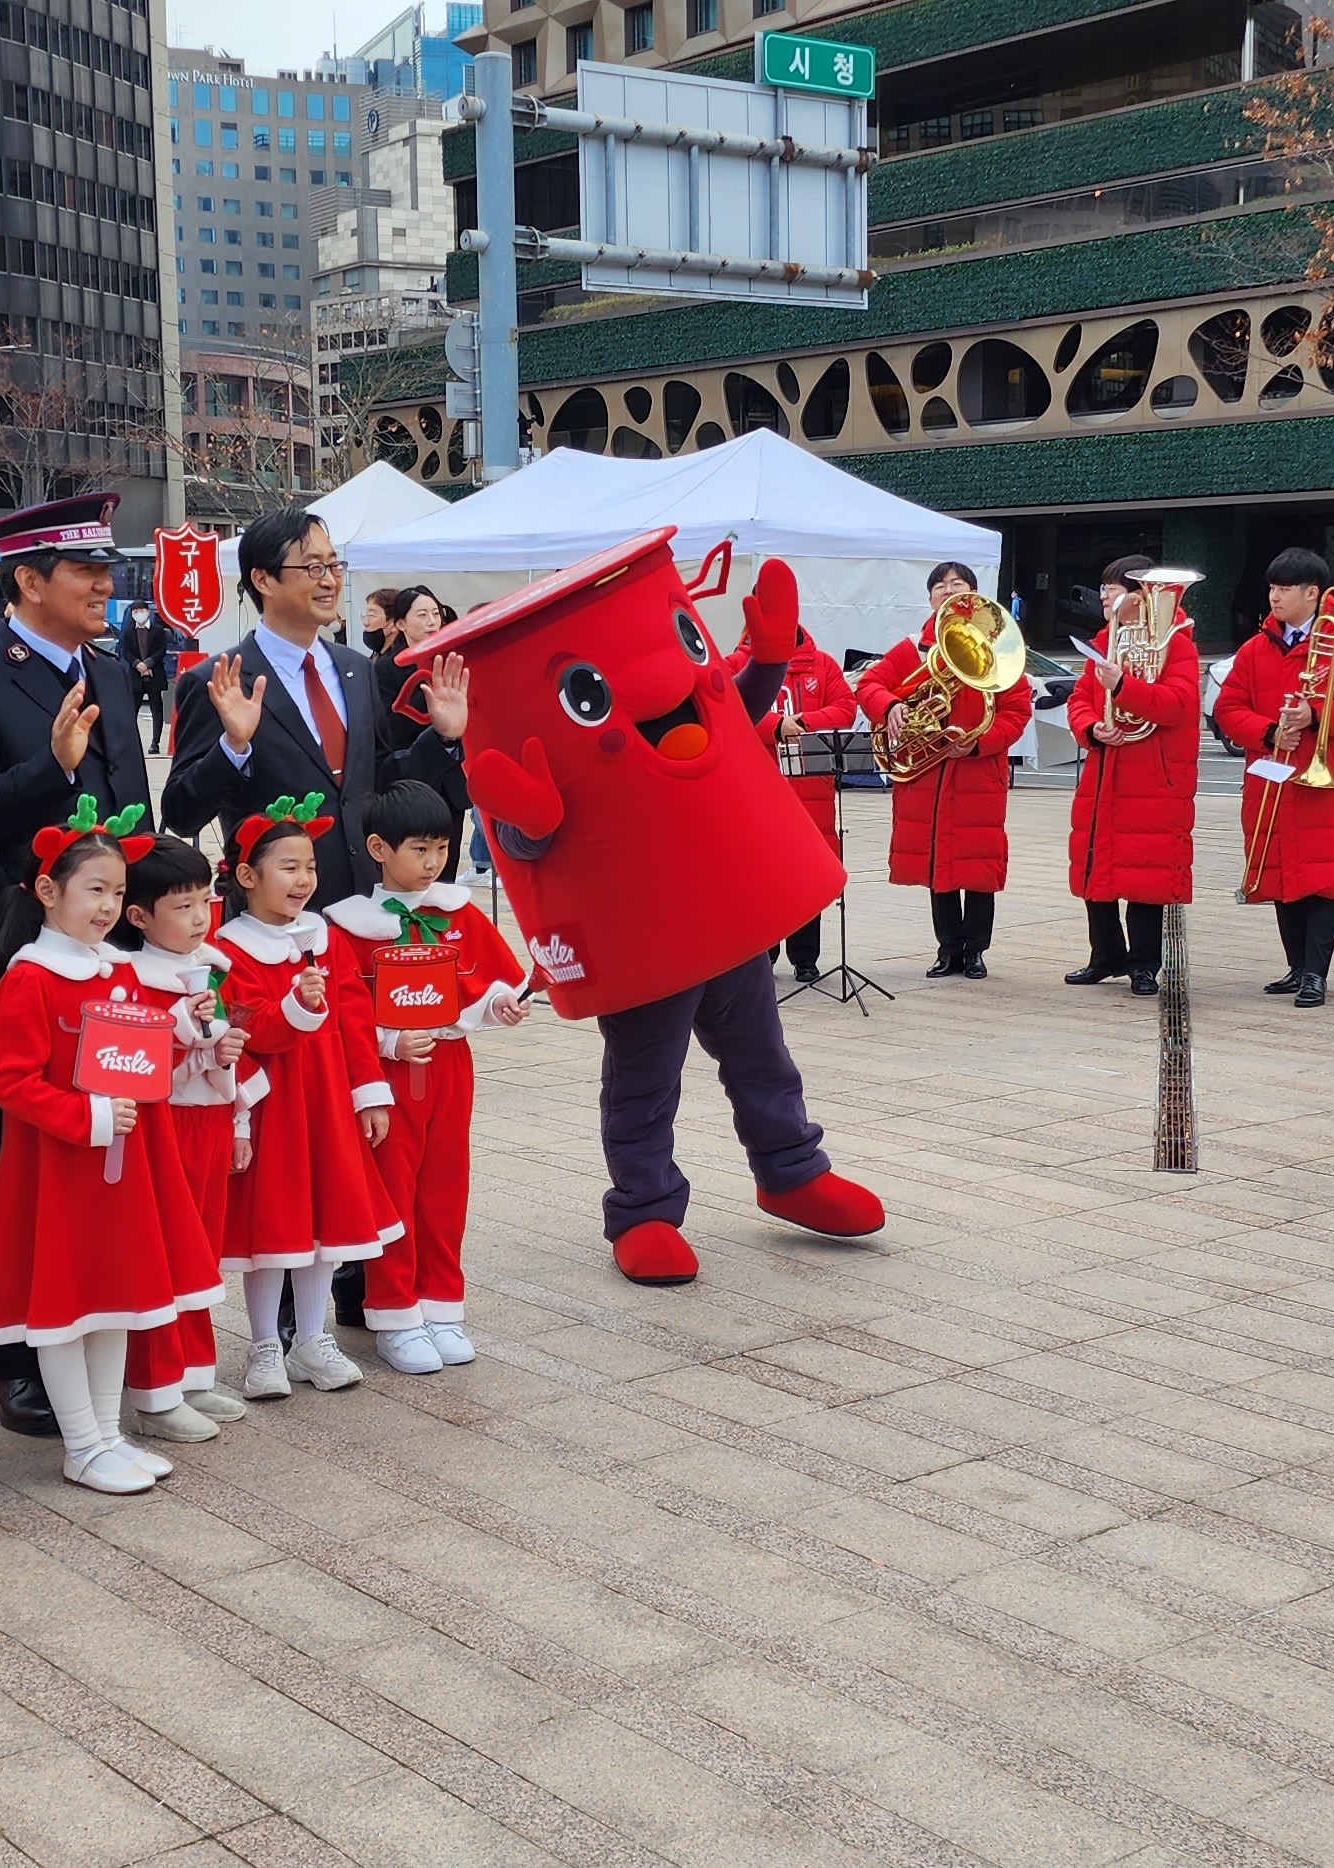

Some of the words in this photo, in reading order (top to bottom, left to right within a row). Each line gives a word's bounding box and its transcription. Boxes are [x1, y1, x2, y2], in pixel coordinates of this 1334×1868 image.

[788, 46, 854, 86] 시청
[59, 529, 80, 541] THE
[178, 541, 203, 623] 구세군
[12, 646, 26, 660] S
[390, 984, 444, 1007] Fissler
[96, 1046, 156, 1076] Fissler
